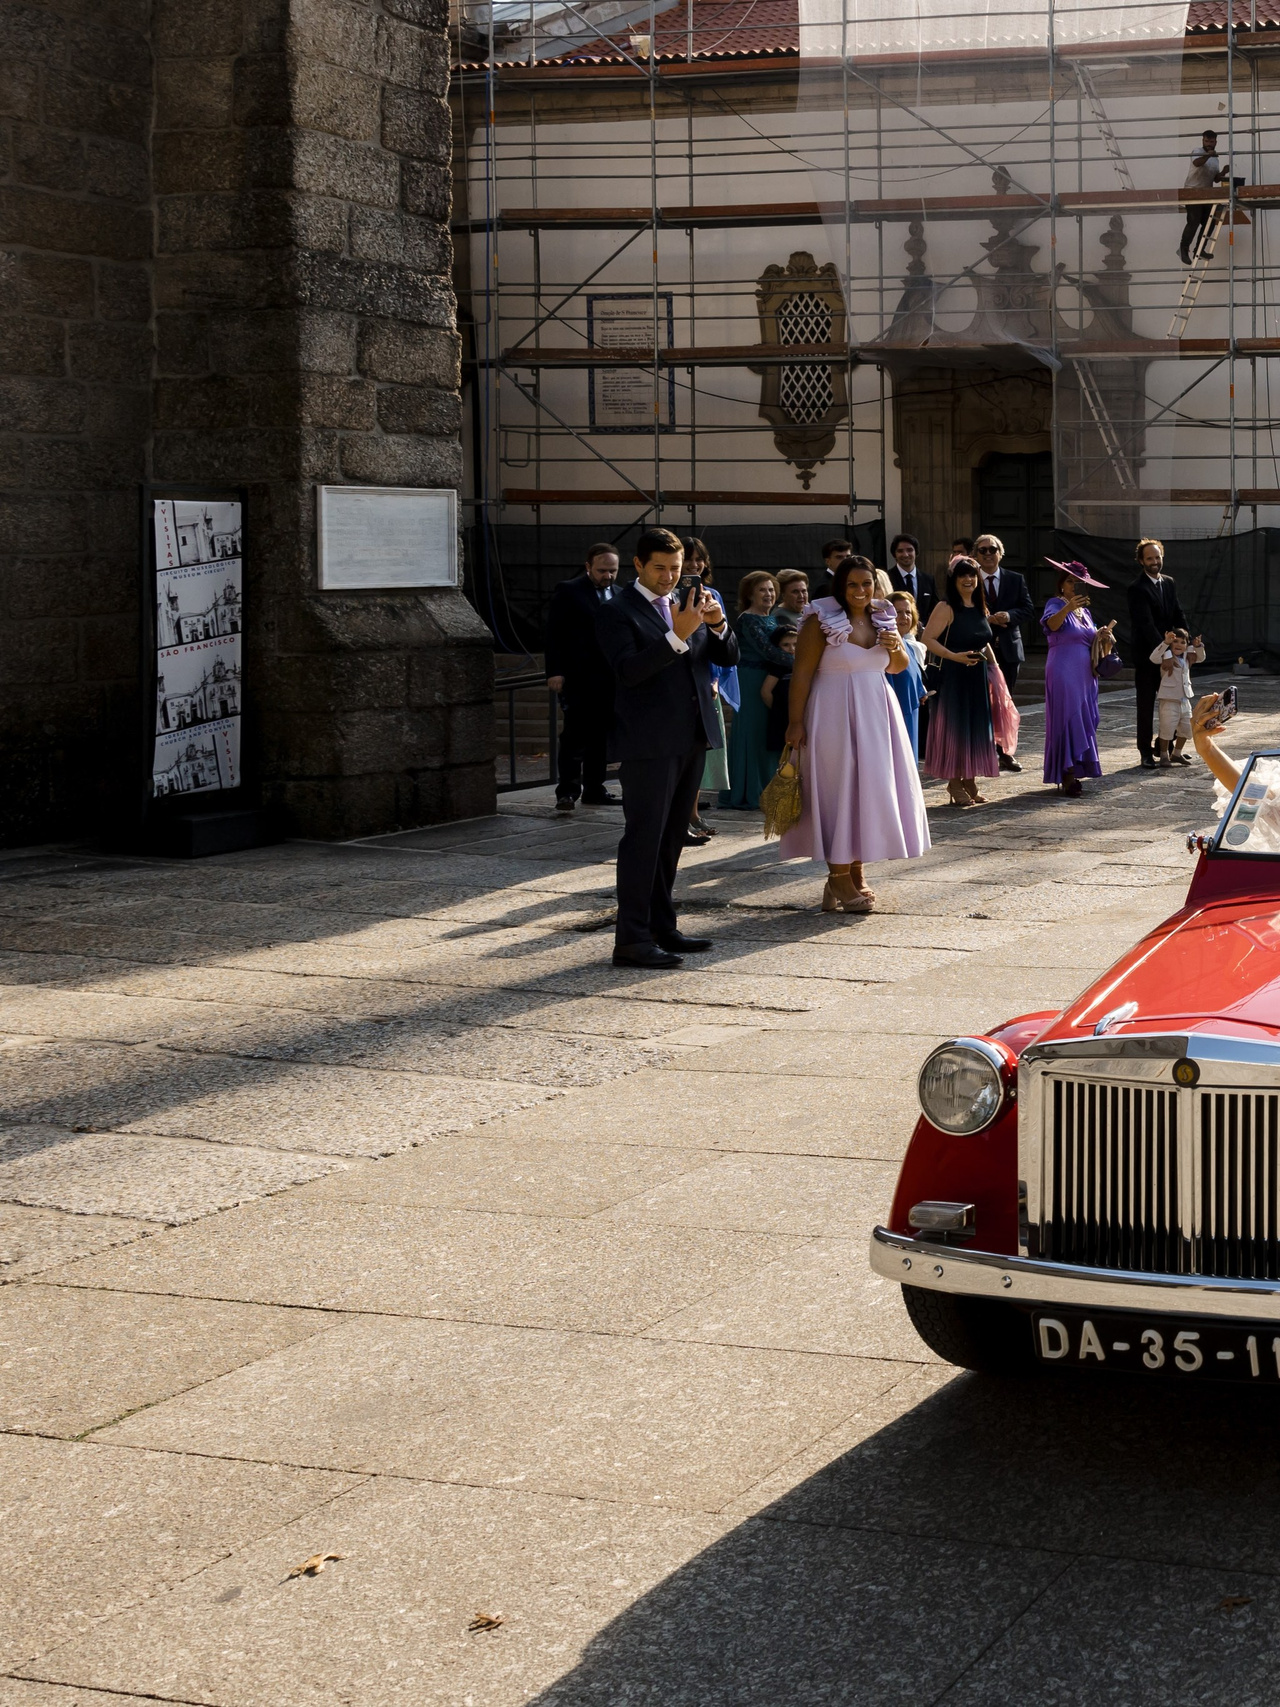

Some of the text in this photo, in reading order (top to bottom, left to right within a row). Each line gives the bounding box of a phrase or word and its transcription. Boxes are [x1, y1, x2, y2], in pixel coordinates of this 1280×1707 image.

[161, 509, 174, 566] VISITAS
[160, 560, 236, 577] CIRCUITO MUSEOLÓGICO
[173, 567, 226, 580] MUSEUM CIRCUIT
[160, 637, 235, 658] SÃO FRANCISCO
[160, 737, 186, 746] CHURCH
[204, 723, 235, 734] CONVENT
[165, 731, 187, 739] IGREJA
[194, 719, 230, 731] CONVENTO
[222, 731, 235, 780] VISITS
